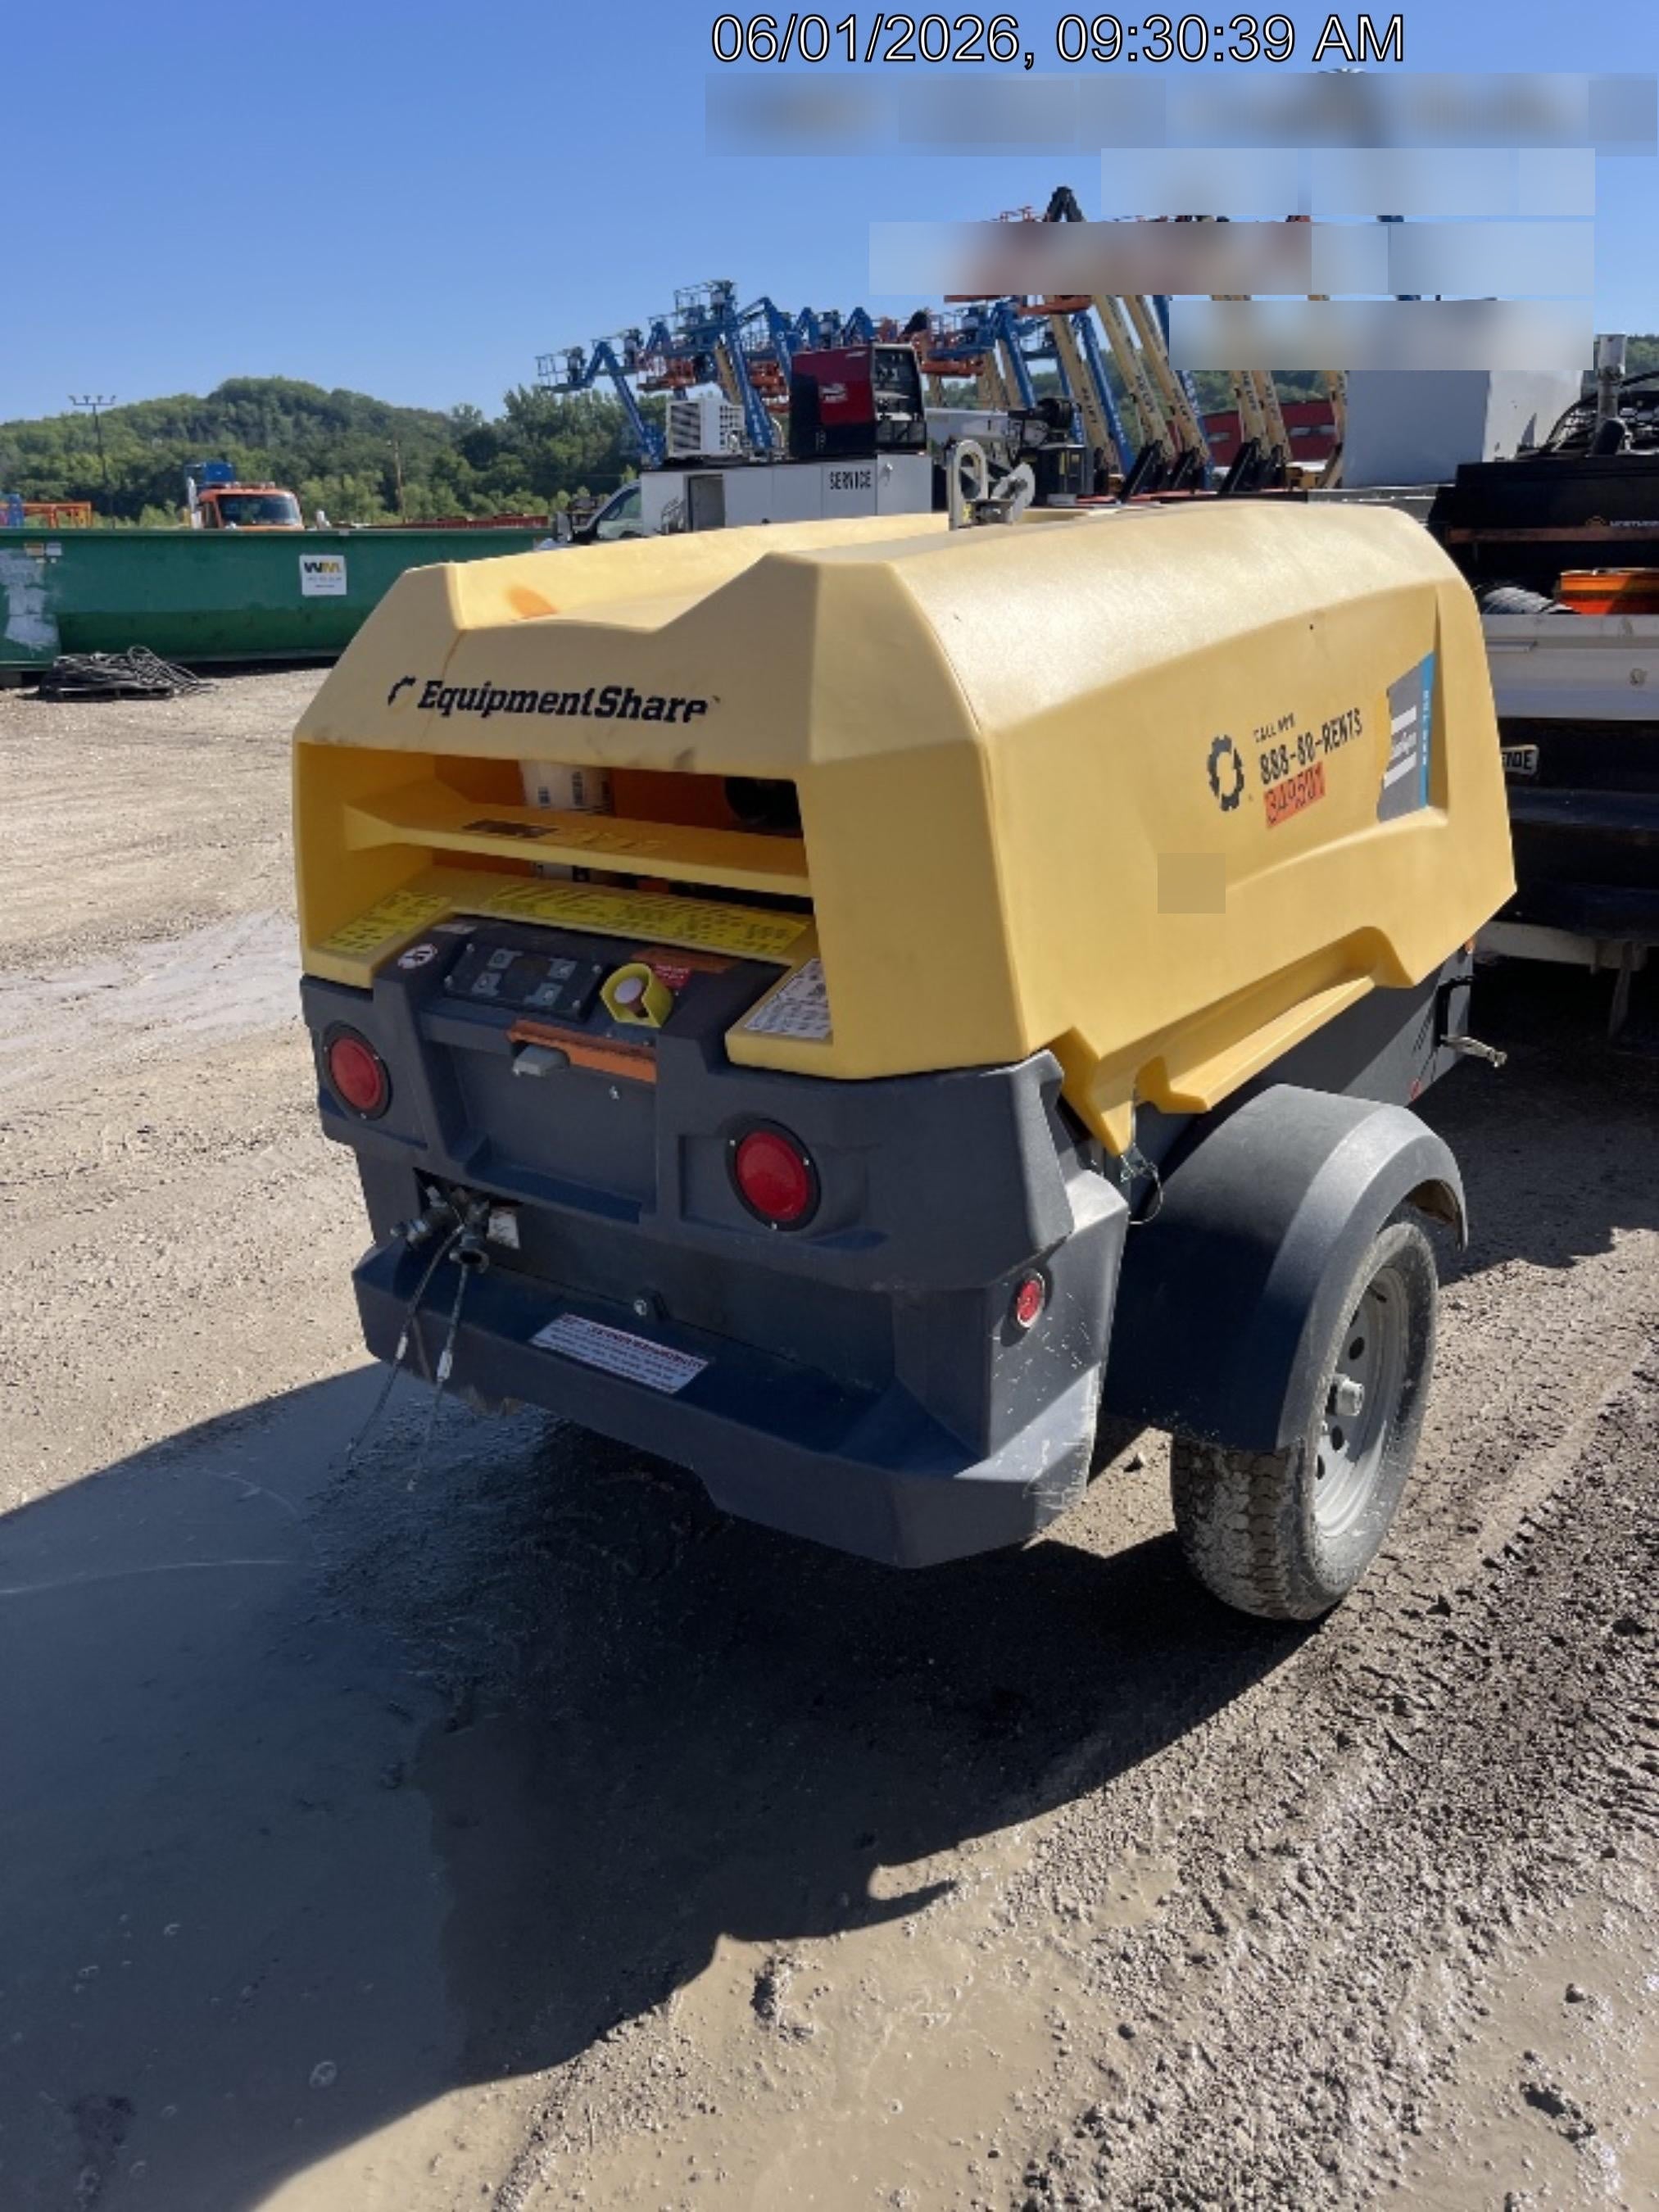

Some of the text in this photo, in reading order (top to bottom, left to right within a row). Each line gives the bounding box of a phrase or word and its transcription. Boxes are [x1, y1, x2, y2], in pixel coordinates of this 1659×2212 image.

[830, 470, 871, 490] SERVICE
[417, 680, 708, 723] EquipmentShare
[1253, 724, 1276, 743] CALL
[1259, 708, 1362, 785] 888-80-RENTS
